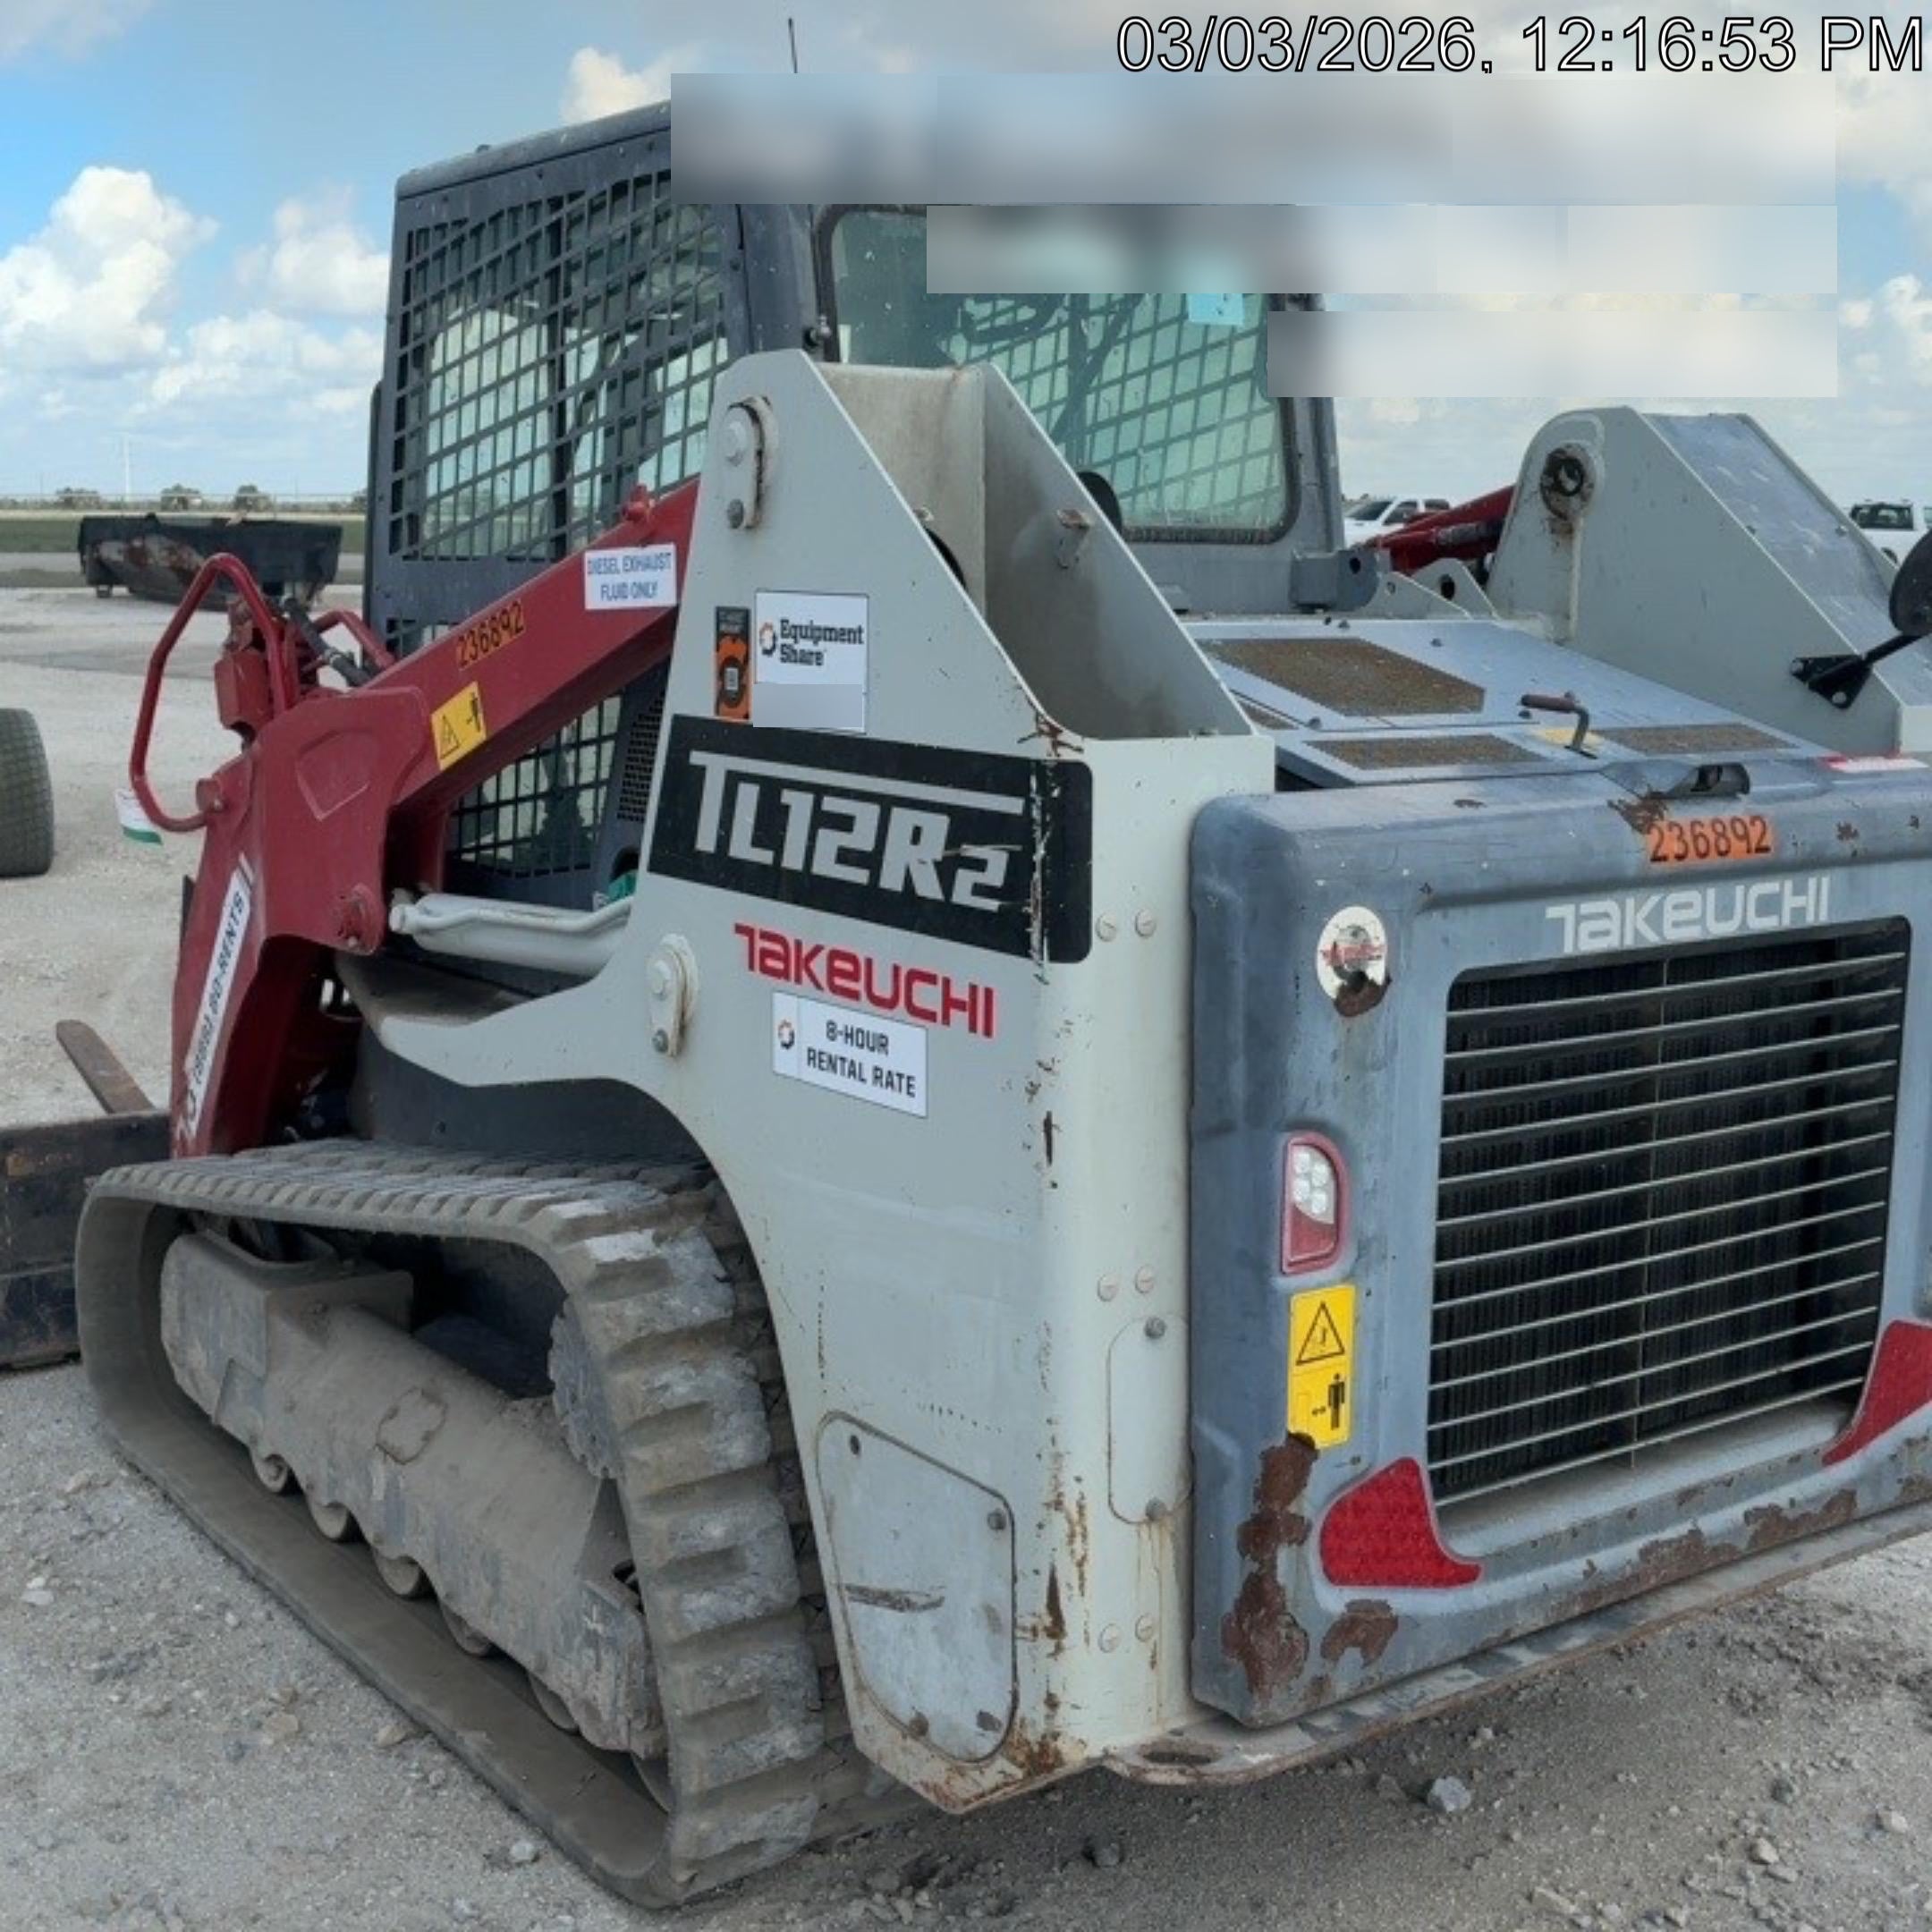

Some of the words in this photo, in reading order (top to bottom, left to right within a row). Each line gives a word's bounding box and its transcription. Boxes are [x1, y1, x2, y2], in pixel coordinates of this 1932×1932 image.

[623, 552, 672, 572] EXHAUST
[600, 581, 628, 600] FLUID
[630, 581, 658, 598] ONLY
[456, 600, 524, 667] 236892
[780, 619, 864, 645] Equipment
[780, 643, 824, 666] Share
[688, 750, 1026, 913] TL12R2
[1649, 815, 1772, 862] 236892
[825, 1020, 890, 1056] 8-HOUR
[806, 1046, 868, 1084] RENTAL
[870, 1063, 917, 1098] RATE
